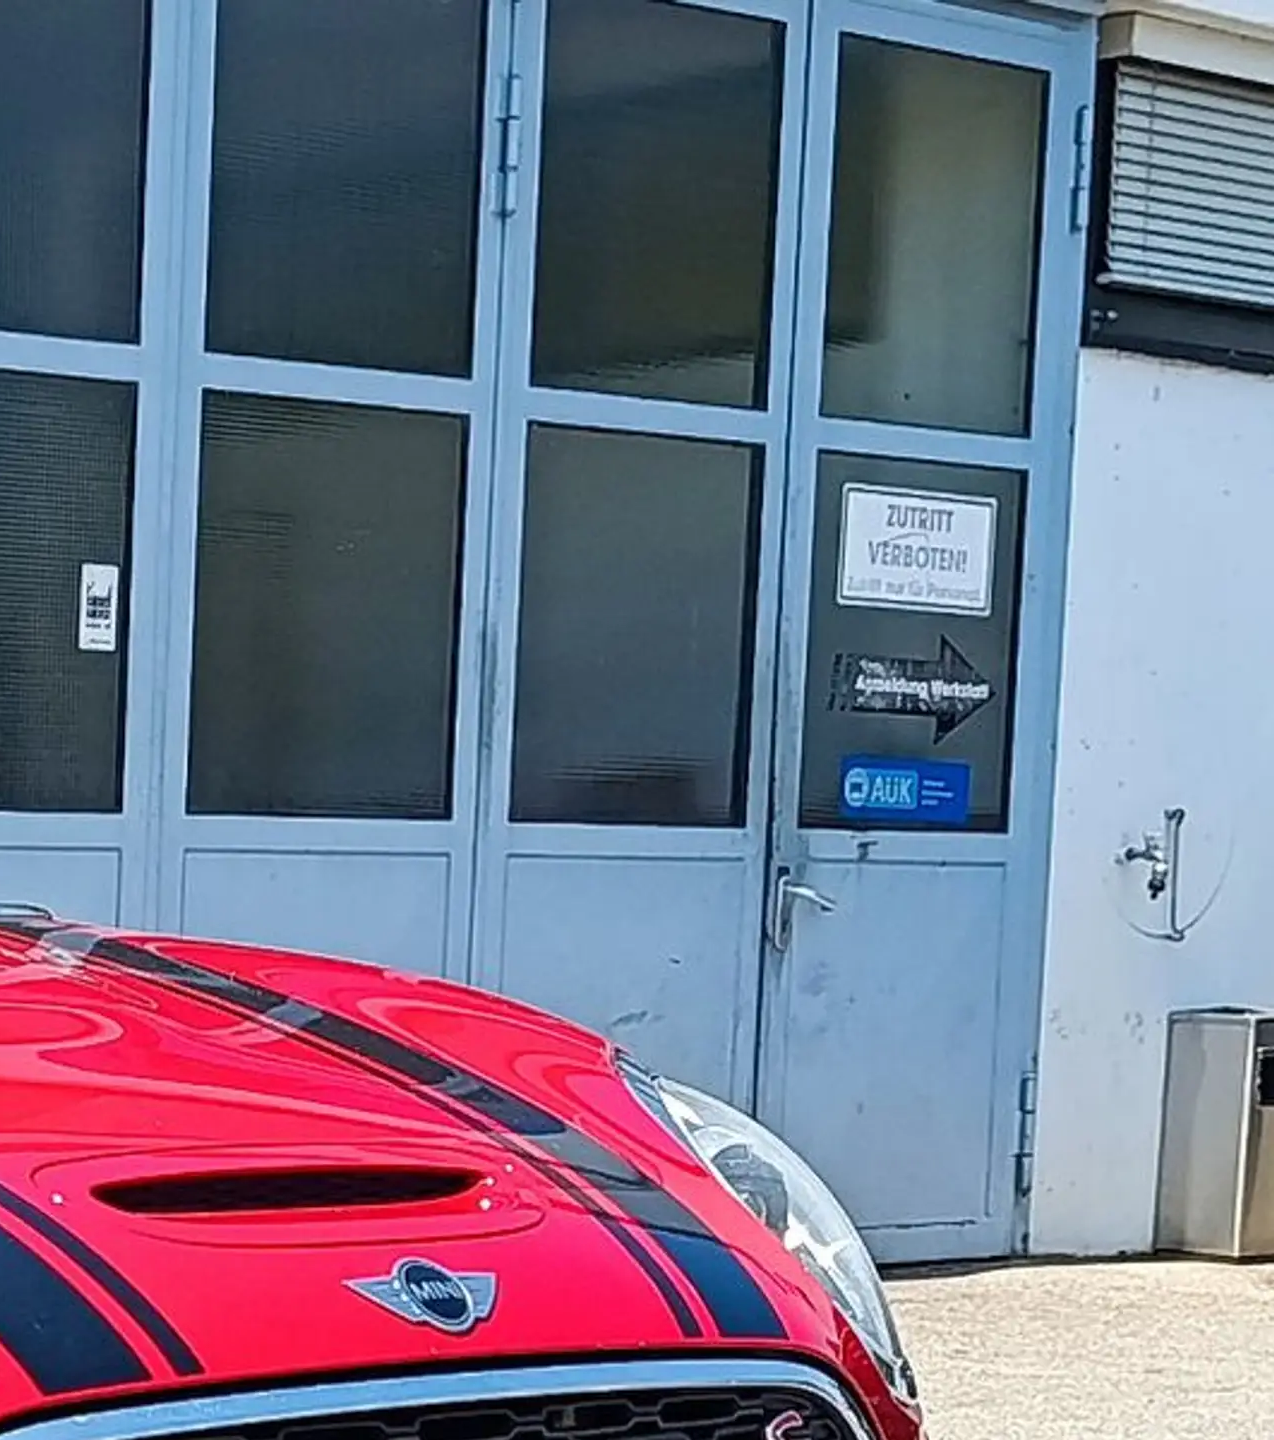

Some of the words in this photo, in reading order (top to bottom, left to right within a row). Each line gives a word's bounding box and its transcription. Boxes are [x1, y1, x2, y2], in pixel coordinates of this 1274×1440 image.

[886, 504, 954, 533] ZUTRITT
[868, 540, 968, 573] VERBOTEN!
[410, 1280, 464, 1301] MINI
